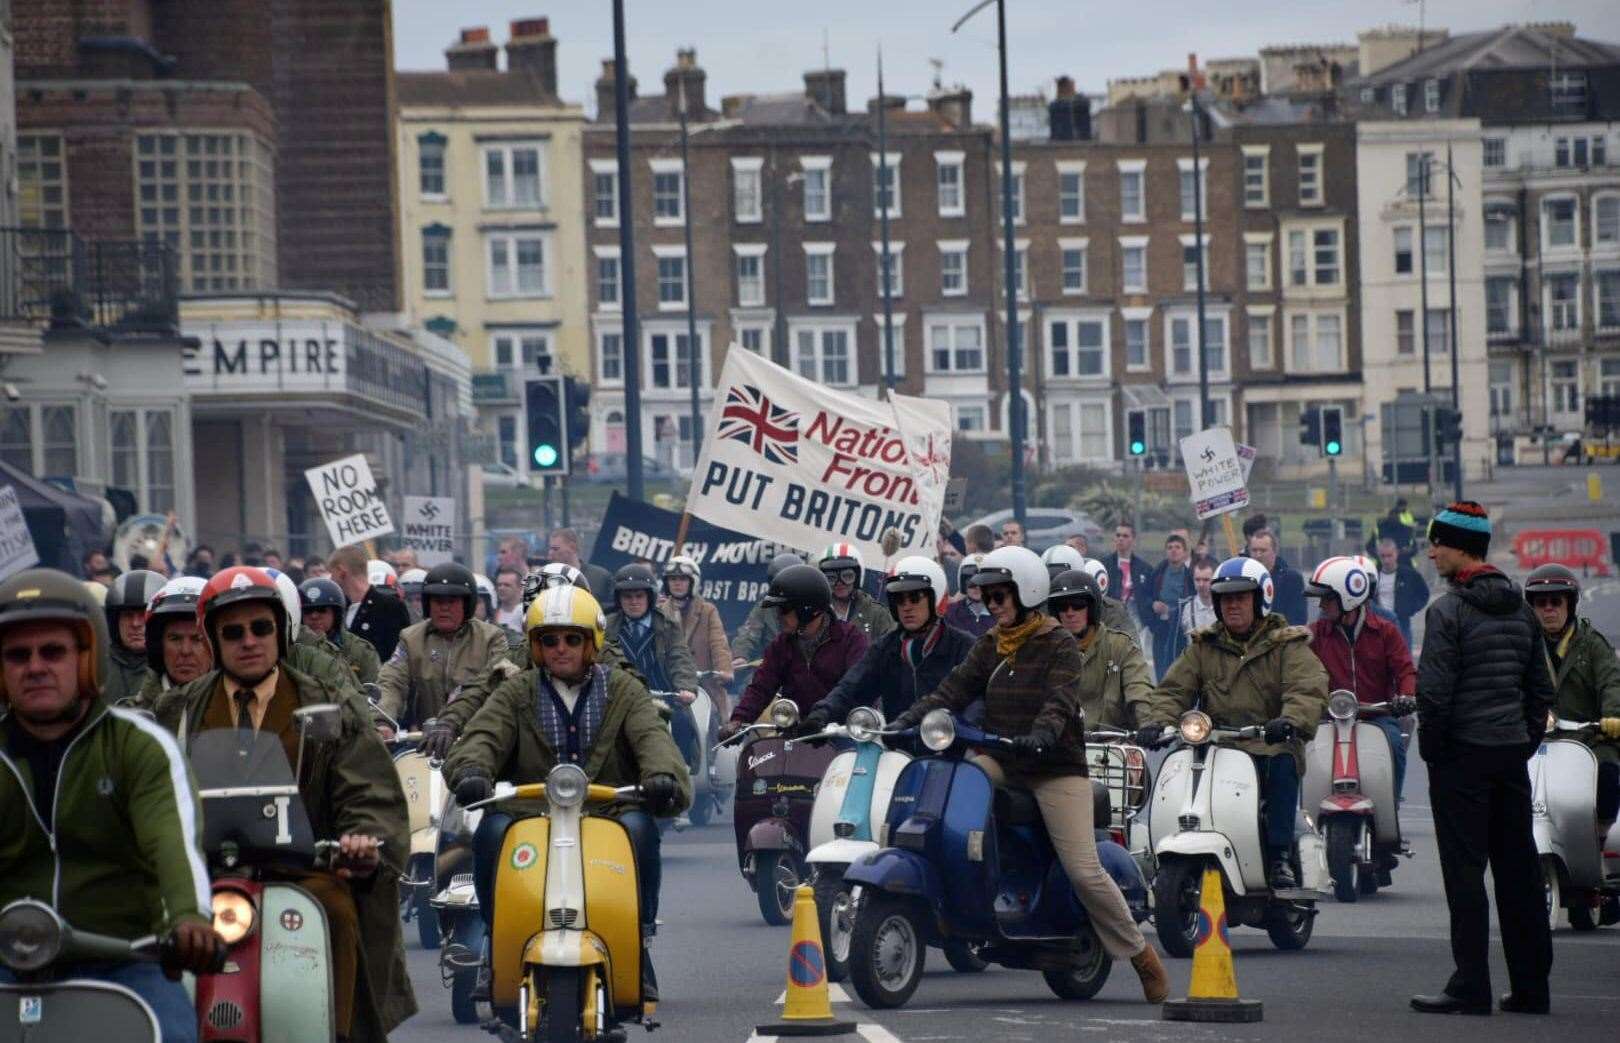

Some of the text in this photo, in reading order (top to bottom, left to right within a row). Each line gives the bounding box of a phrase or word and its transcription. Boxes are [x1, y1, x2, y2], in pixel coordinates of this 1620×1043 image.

[182, 337, 340, 375] EMPIRE
[804, 411, 909, 466] Natio
[322, 464, 359, 495] NO
[322, 486, 378, 520] ROOM
[701, 460, 922, 549] PUT BRITONS
[336, 505, 388, 542] HERE
[405, 523, 451, 537] WHITE
[402, 537, 453, 552] POWER
[699, 580, 731, 601] AST
